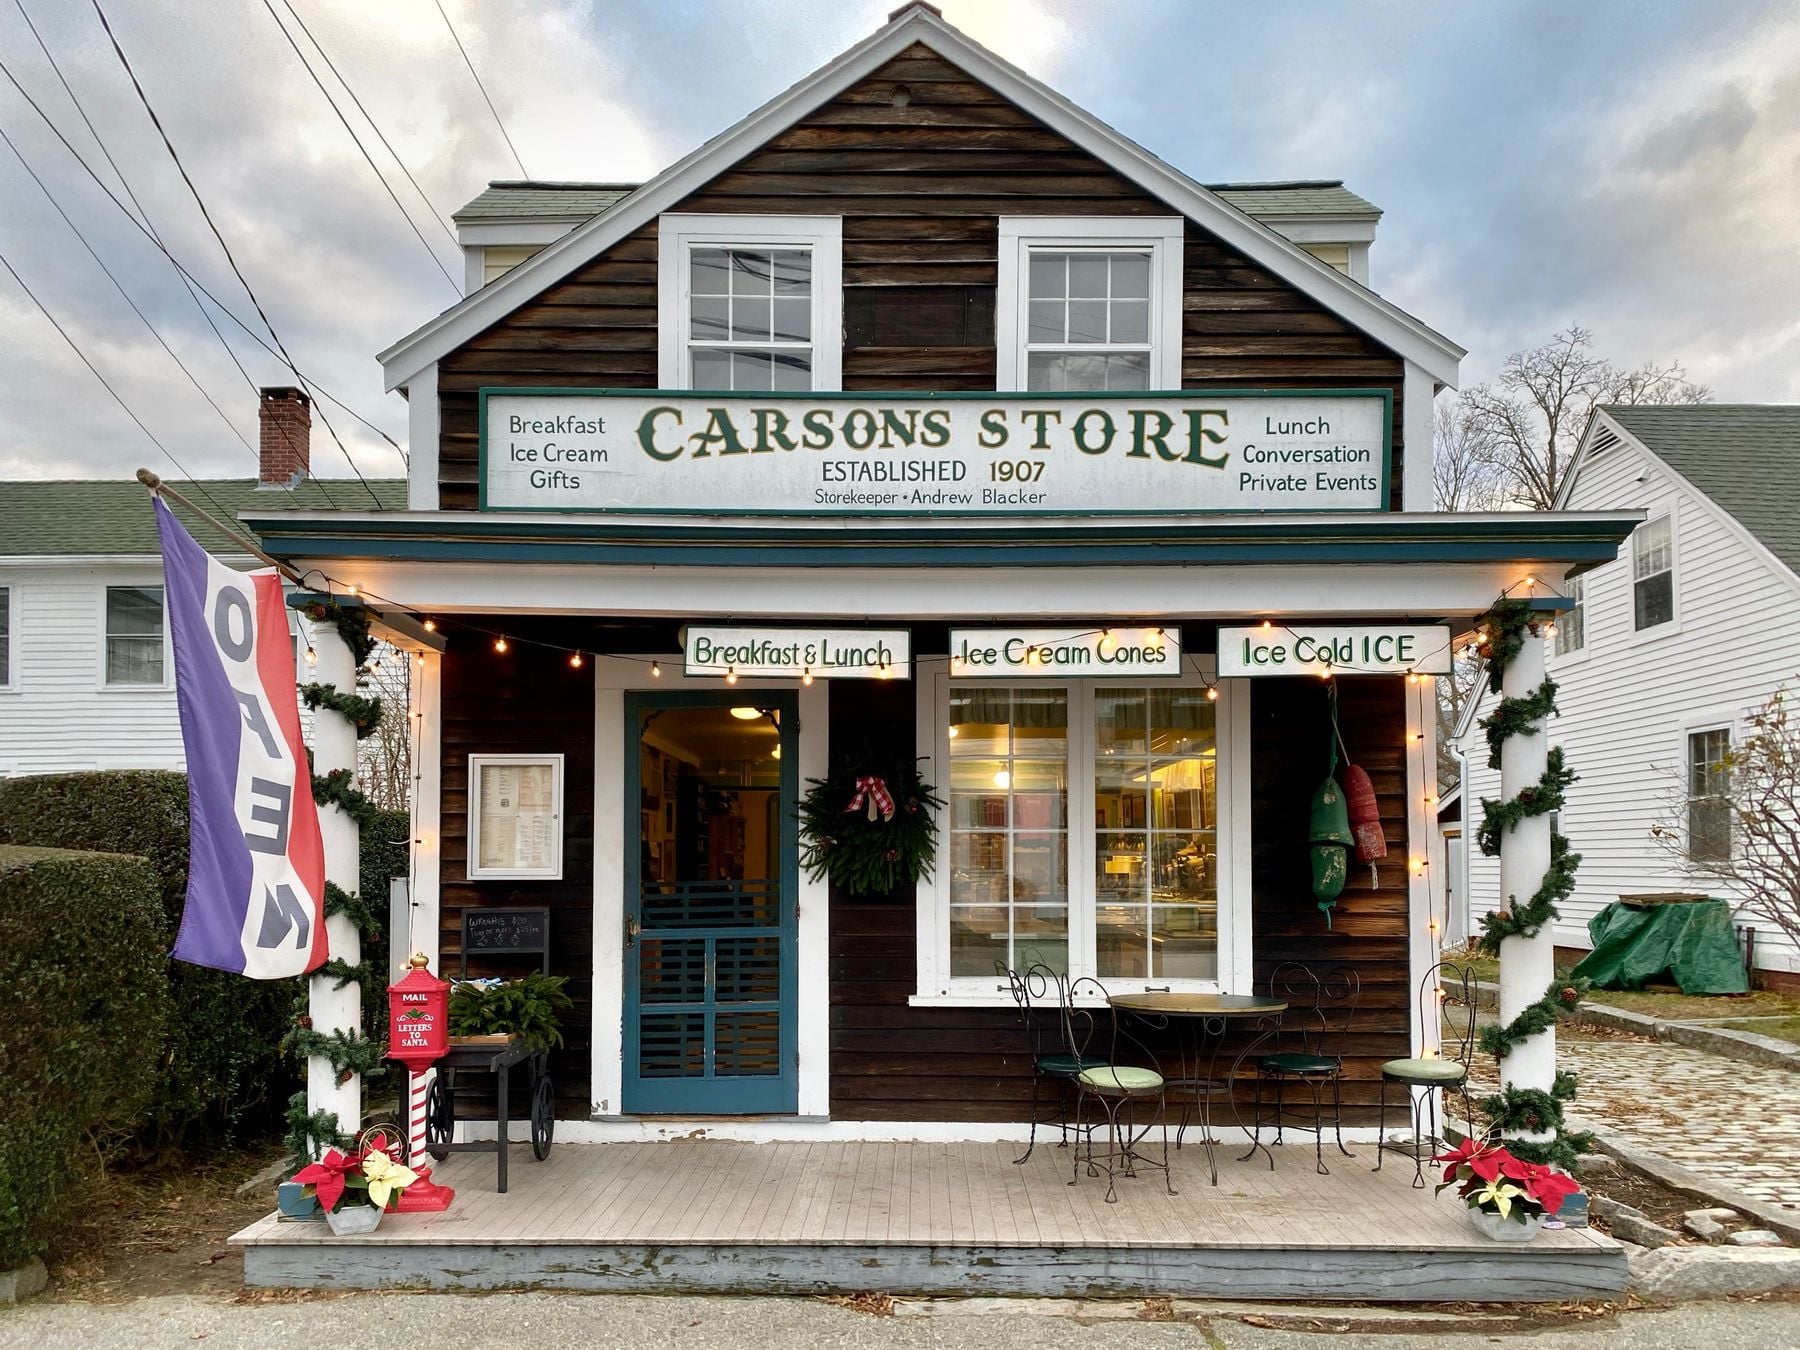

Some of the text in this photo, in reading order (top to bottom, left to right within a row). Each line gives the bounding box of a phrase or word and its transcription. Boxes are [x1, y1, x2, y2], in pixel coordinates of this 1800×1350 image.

[509, 415, 606, 434] Breakfast
[1266, 416, 1330, 435] Lunch
[634, 406, 1231, 471] CARSONS STORE
[510, 442, 608, 463] Ice Cream
[1243, 444, 1370, 463] Conversation
[530, 469, 580, 490] Gifts
[822, 460, 1046, 482] ESTABLISHED 1907
[1239, 472, 1377, 491] Private Events
[815, 488, 1047, 507] Storekeeper Andrew Blacker
[694, 636, 892, 666] Breakfast & Lunch
[960, 637, 1166, 665] Ice Cream Cones
[1243, 634, 1416, 665] Ice Cold ICE
[398, 1024, 432, 1032] LETTERS
[402, 1039, 428, 1047] SANTA
